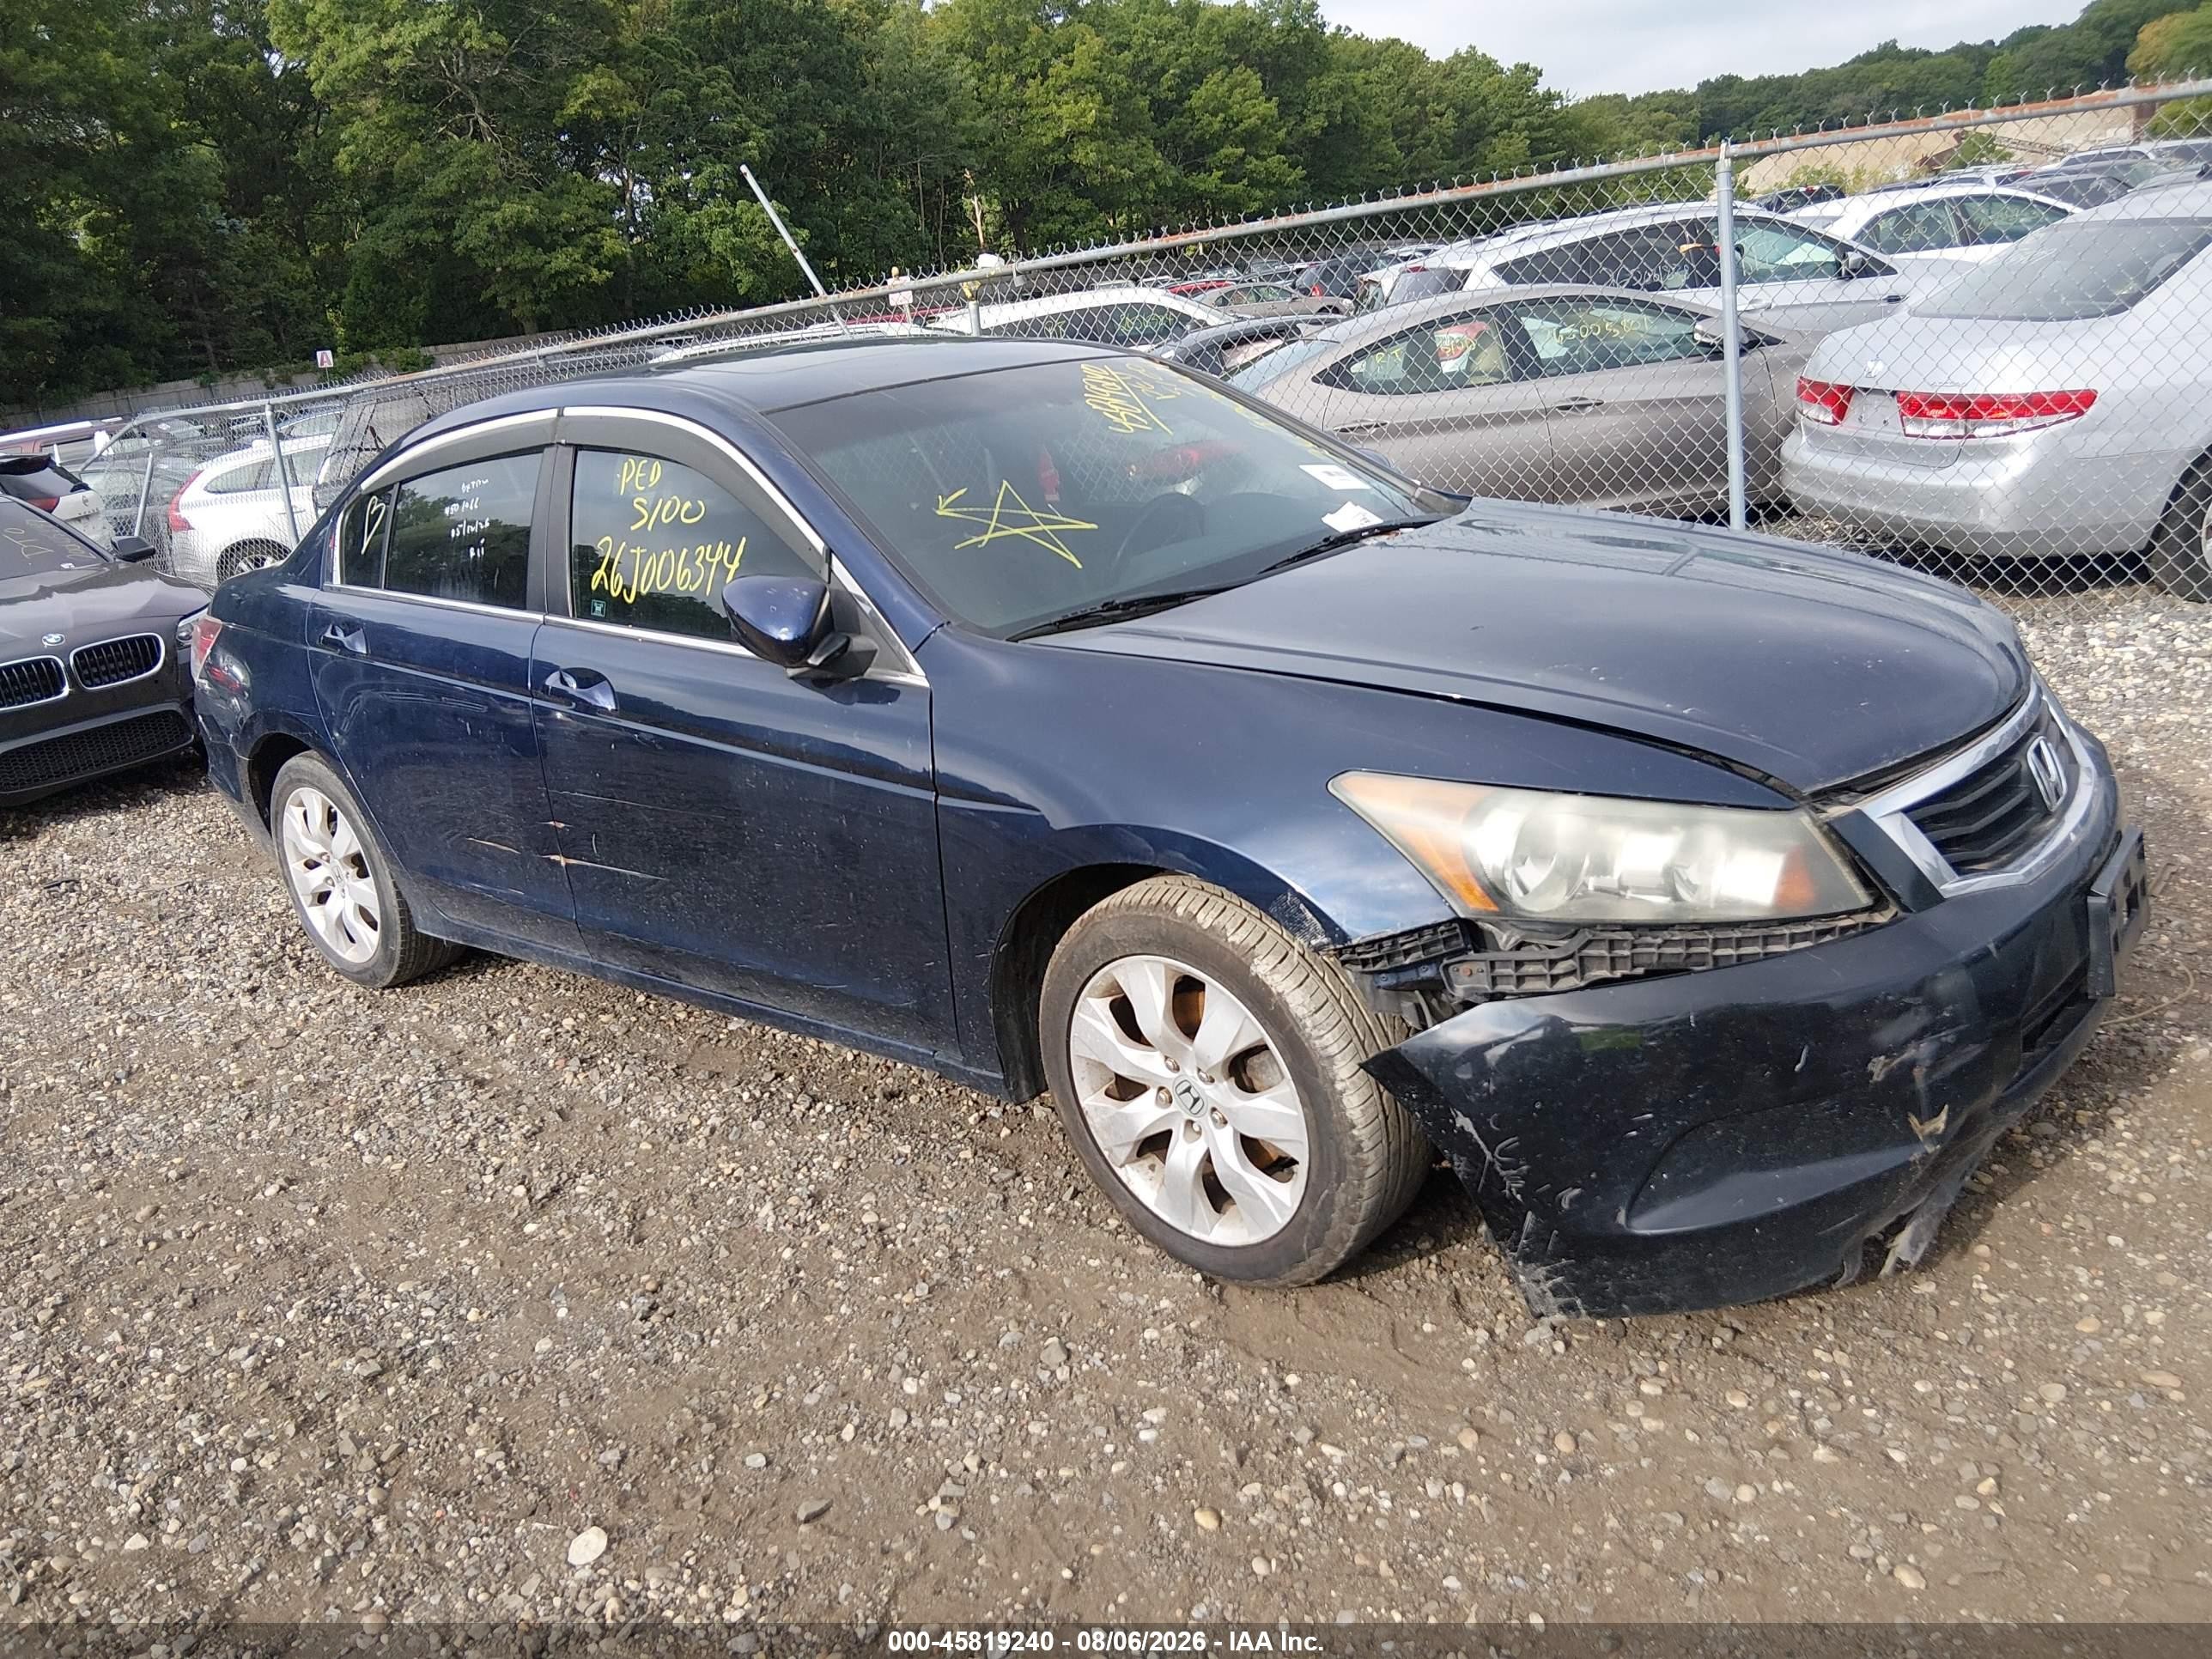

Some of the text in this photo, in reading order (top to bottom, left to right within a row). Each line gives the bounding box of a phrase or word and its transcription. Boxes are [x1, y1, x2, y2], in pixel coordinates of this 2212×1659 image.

[319, 351, 332, 367] A
[619, 458, 662, 495] PED
[591, 536, 747, 604] 26J006344
